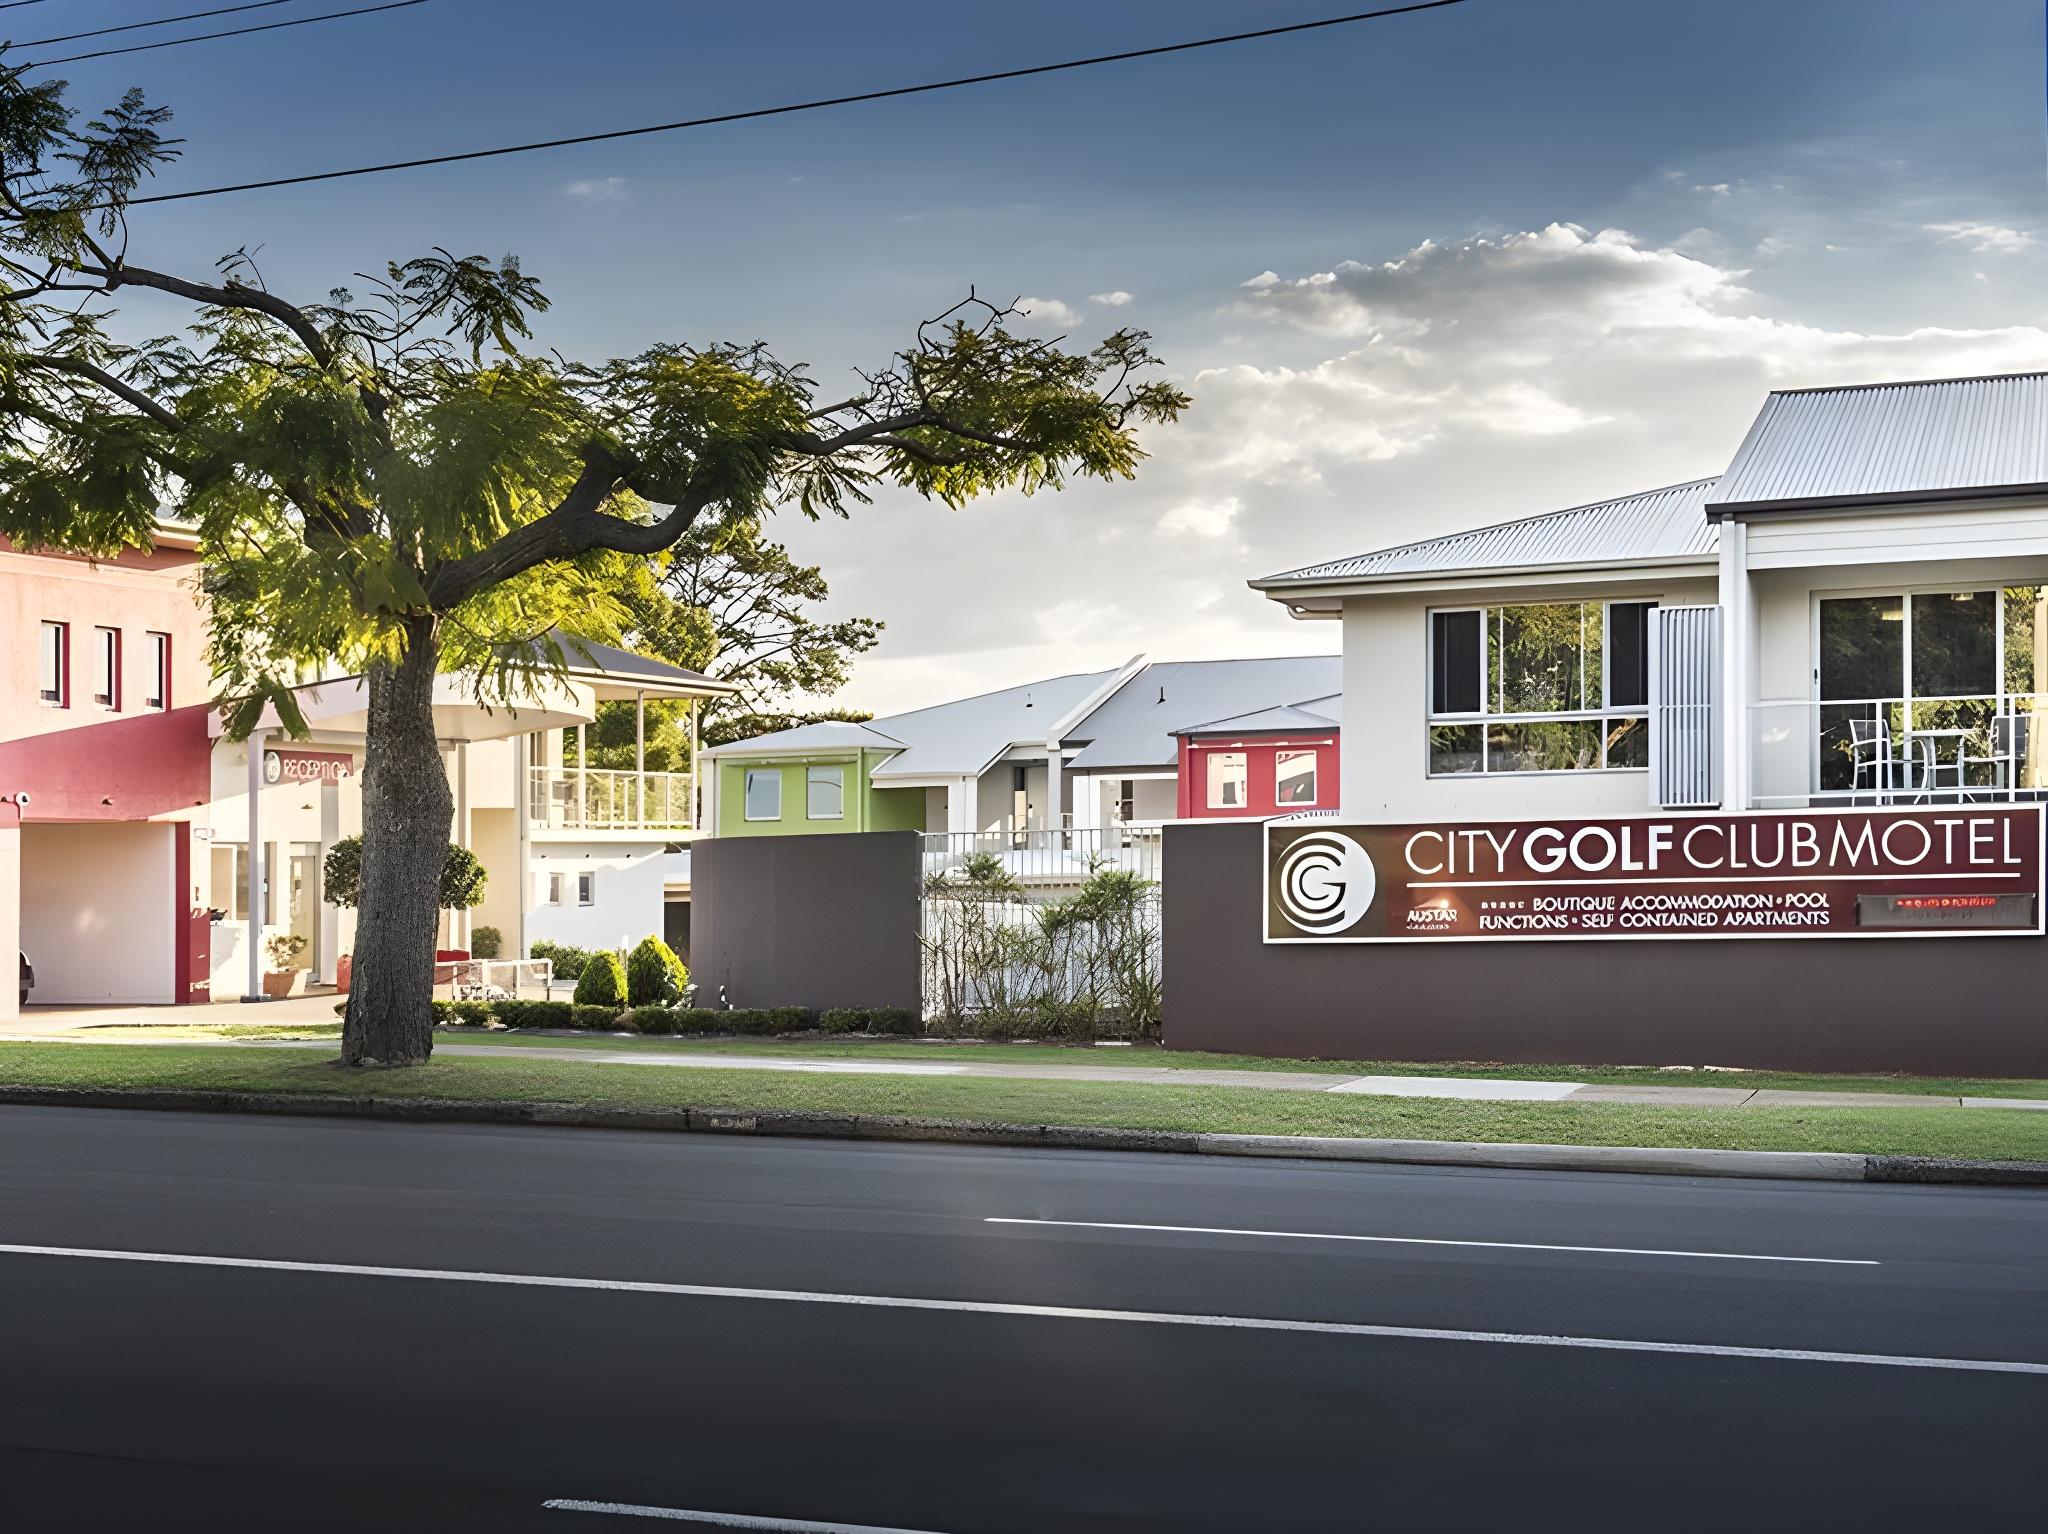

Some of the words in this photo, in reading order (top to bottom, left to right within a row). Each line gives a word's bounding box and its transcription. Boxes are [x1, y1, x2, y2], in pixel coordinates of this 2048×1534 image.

[1405, 828, 1517, 874] CITY
[1522, 825, 1674, 873] GOLF
[1682, 822, 1821, 869] CLUB
[1829, 817, 2022, 868] MOTEL
[1533, 896, 1616, 911] BOUTIQUE
[1619, 894, 1773, 910] ACCOMMODATION
[1785, 892, 1830, 908] POOL
[1479, 914, 1569, 930] FUNCTIONS
[1581, 913, 1614, 929] SELF
[1619, 912, 1719, 928] CONTAINED
[1723, 910, 1830, 926] APARTMENTS
